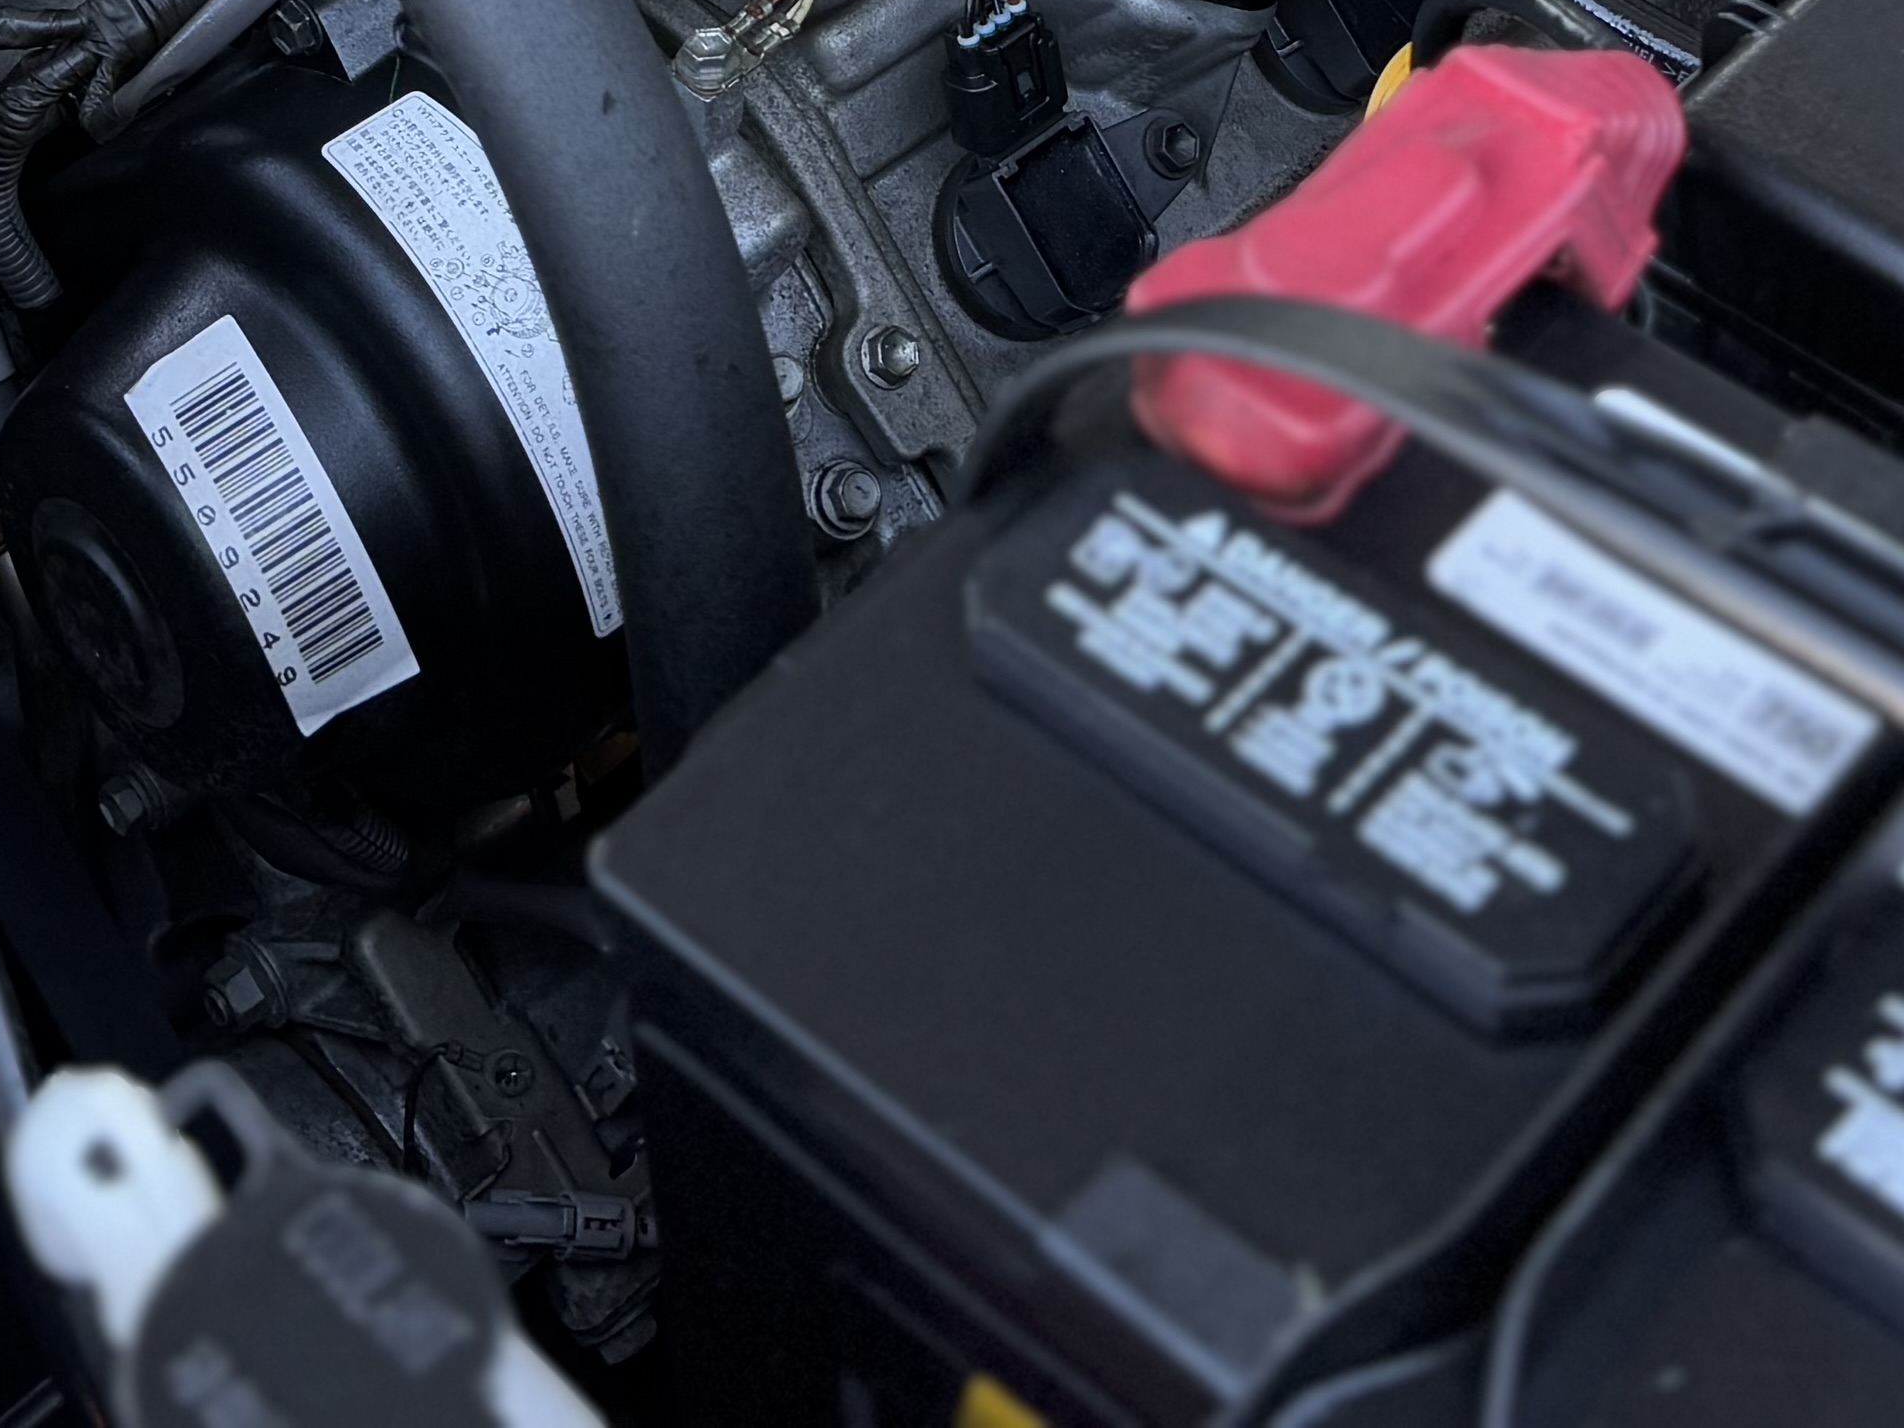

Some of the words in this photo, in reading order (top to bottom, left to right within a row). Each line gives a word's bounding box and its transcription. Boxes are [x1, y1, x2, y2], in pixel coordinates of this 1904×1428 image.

[518, 369, 537, 393] FOR
[149, 424, 301, 688] 5509249
[529, 426, 544, 444] DO
[540, 447, 557, 470] NOT
[552, 473, 575, 510] TOUCH
[568, 511, 589, 546] THESE
[583, 547, 600, 576] FOUR
